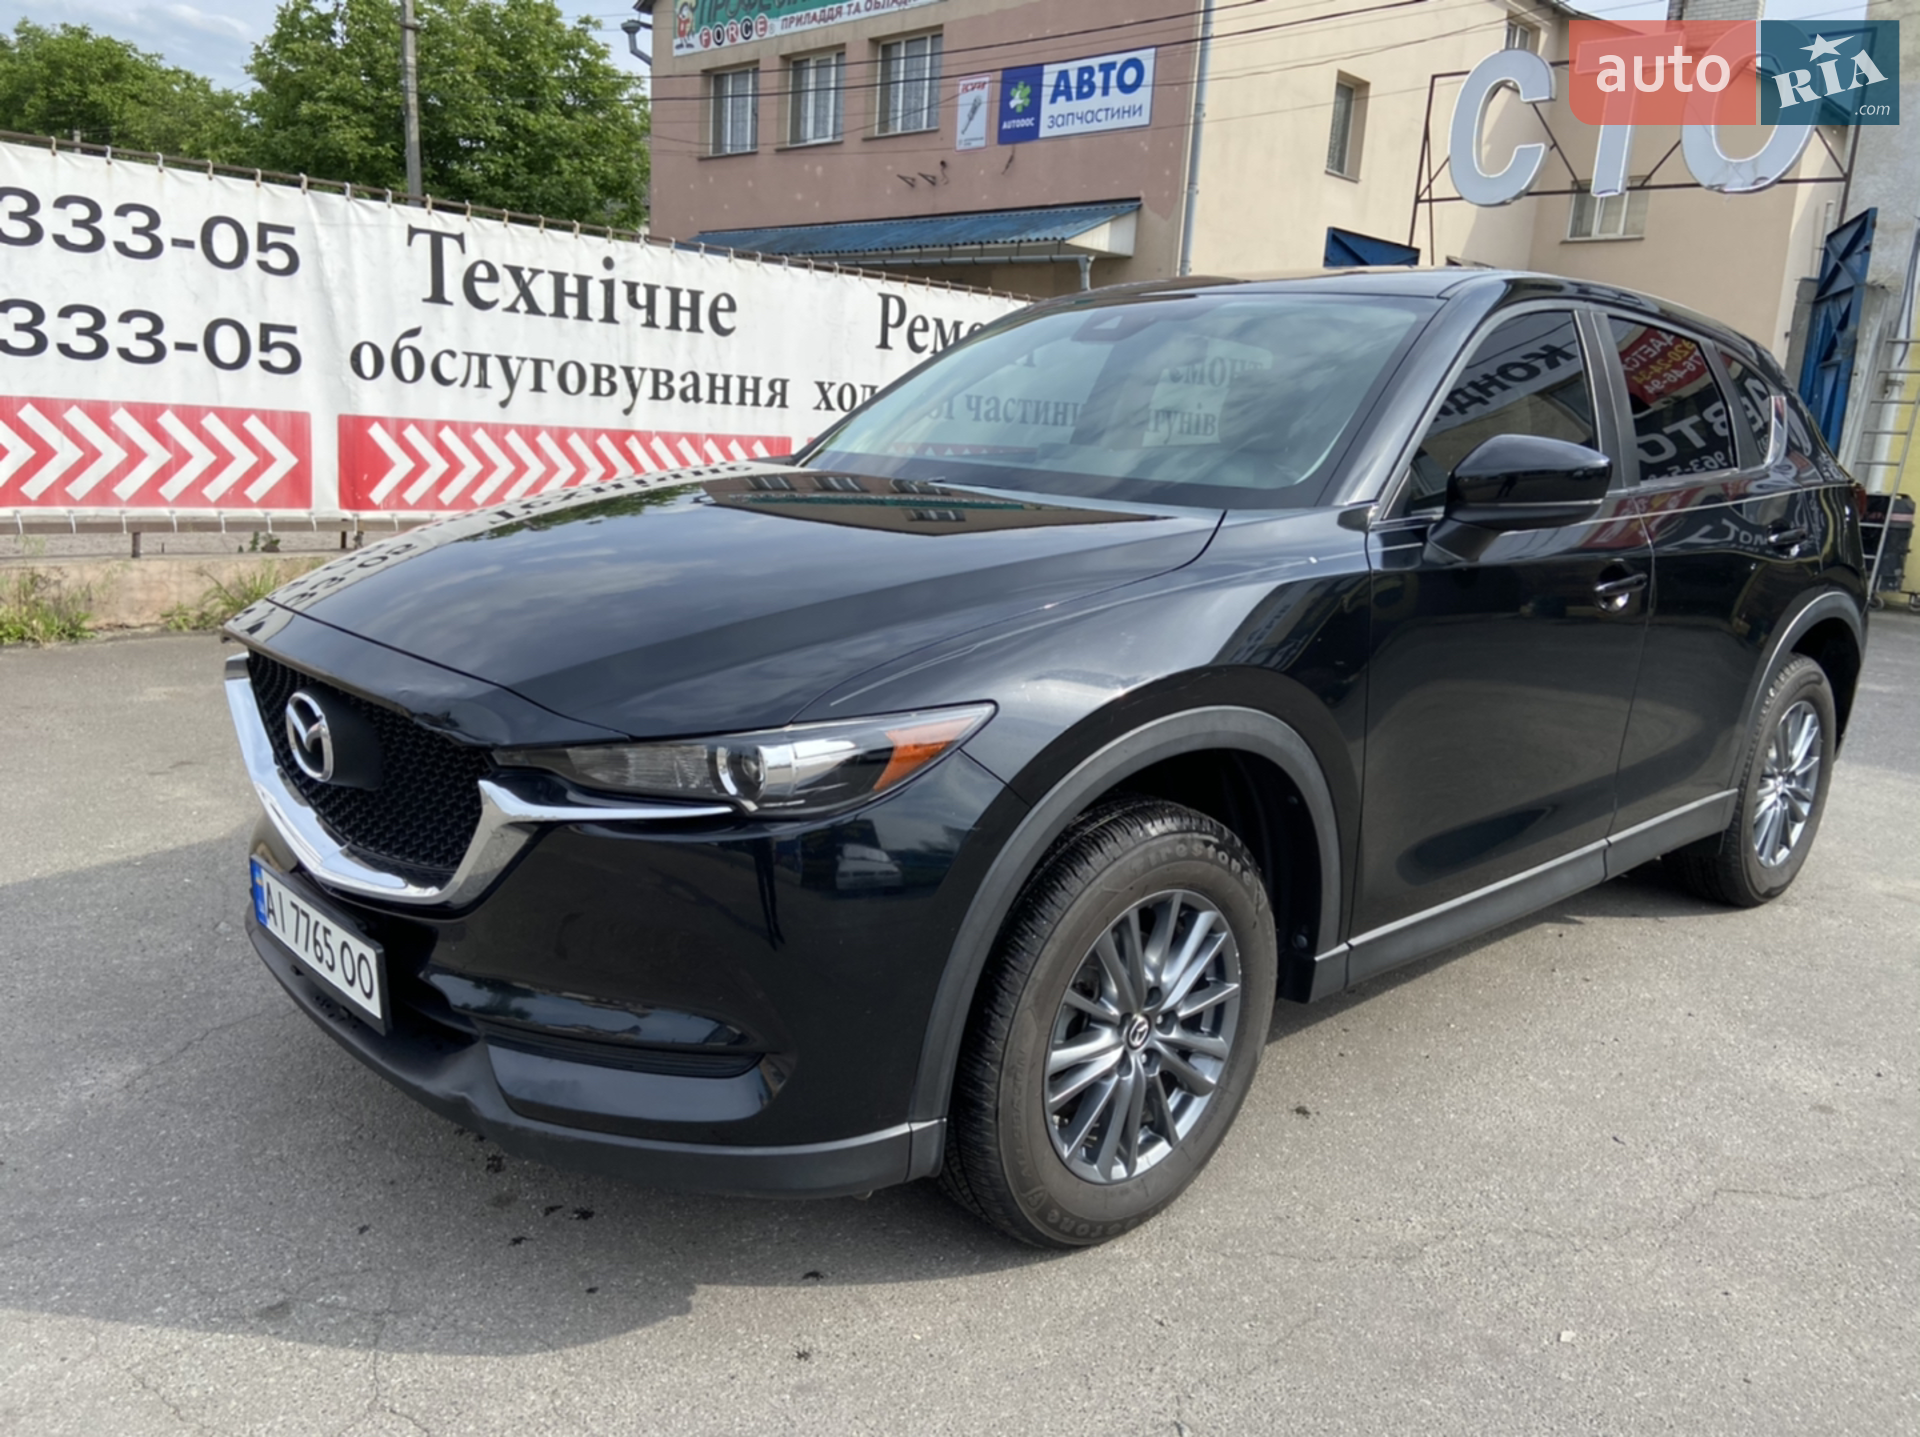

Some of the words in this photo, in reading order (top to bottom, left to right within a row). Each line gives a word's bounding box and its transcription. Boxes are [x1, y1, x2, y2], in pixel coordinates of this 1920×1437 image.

[699, 14, 768, 48] FORCE
[780, 3, 843, 31] ПРИЛАДДЯ
[845, 1, 862, 16] ТА
[865, 0, 918, 12] ОБЛА
[1048, 57, 1145, 105] АВТО
[1002, 116, 1035, 130] AUTODOC
[1047, 103, 1143, 129] запчастини
[0, 186, 300, 276] 333-05
[407, 224, 738, 337] Технічне
[0, 298, 302, 375] 333-05
[350, 326, 790, 416] обслуговування
[1131, 841, 1252, 886] Firestone
[266, 881, 286, 934] AI
[290, 900, 335, 973] 7765
[340, 940, 374, 1000] OO
